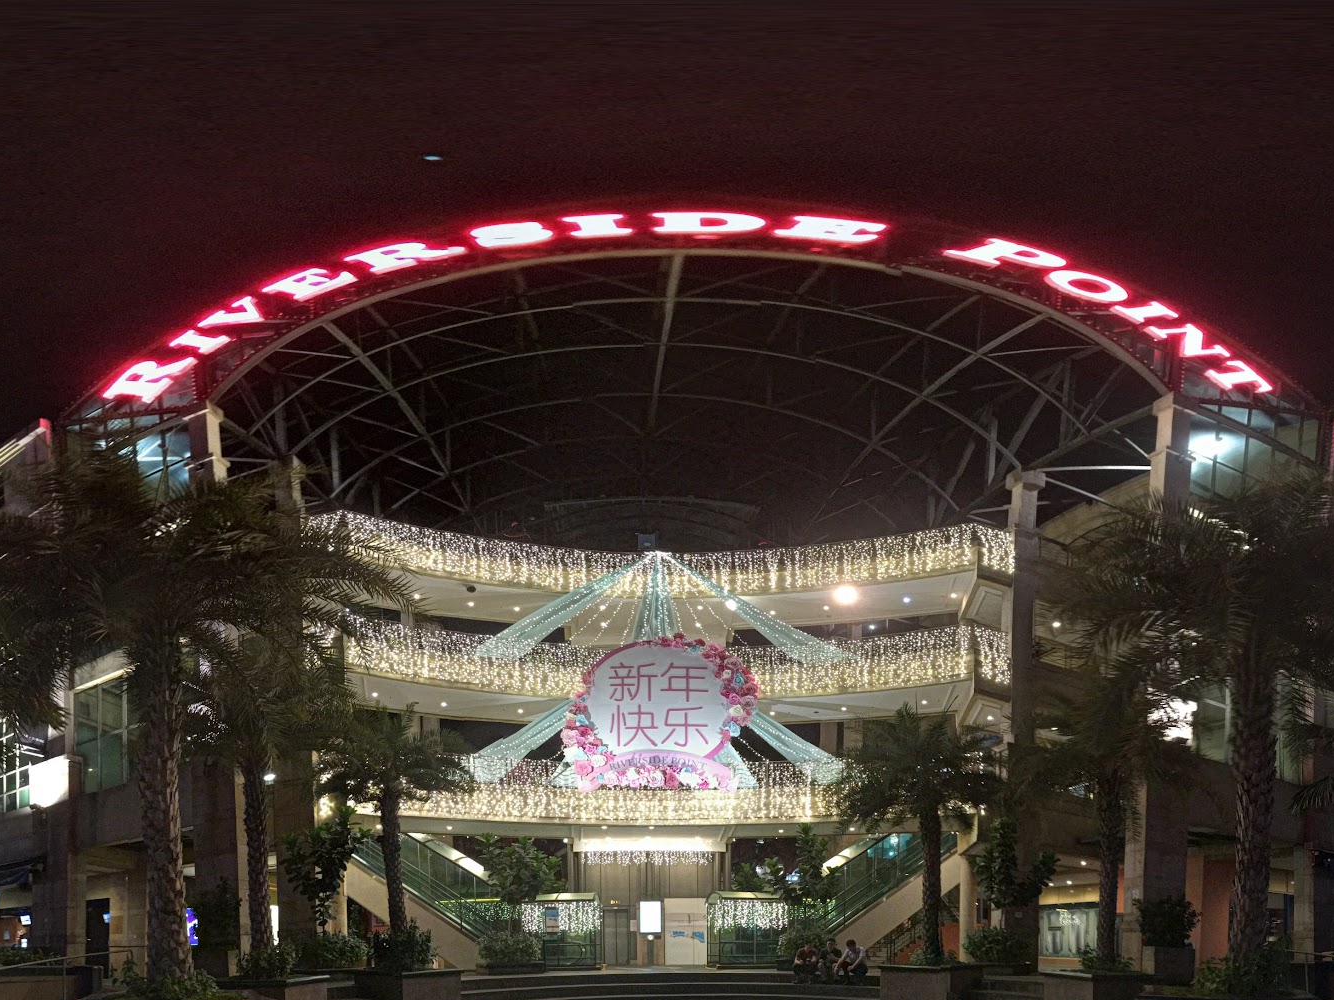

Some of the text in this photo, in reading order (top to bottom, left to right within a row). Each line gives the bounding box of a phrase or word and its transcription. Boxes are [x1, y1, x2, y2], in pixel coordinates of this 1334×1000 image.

[102, 211, 1273, 404] RIVERSIDE POINT
[608, 662, 709, 702] 新年
[609, 704, 709, 747] 快乐
[609, 756, 707, 772] RIVERSIDE POINT
